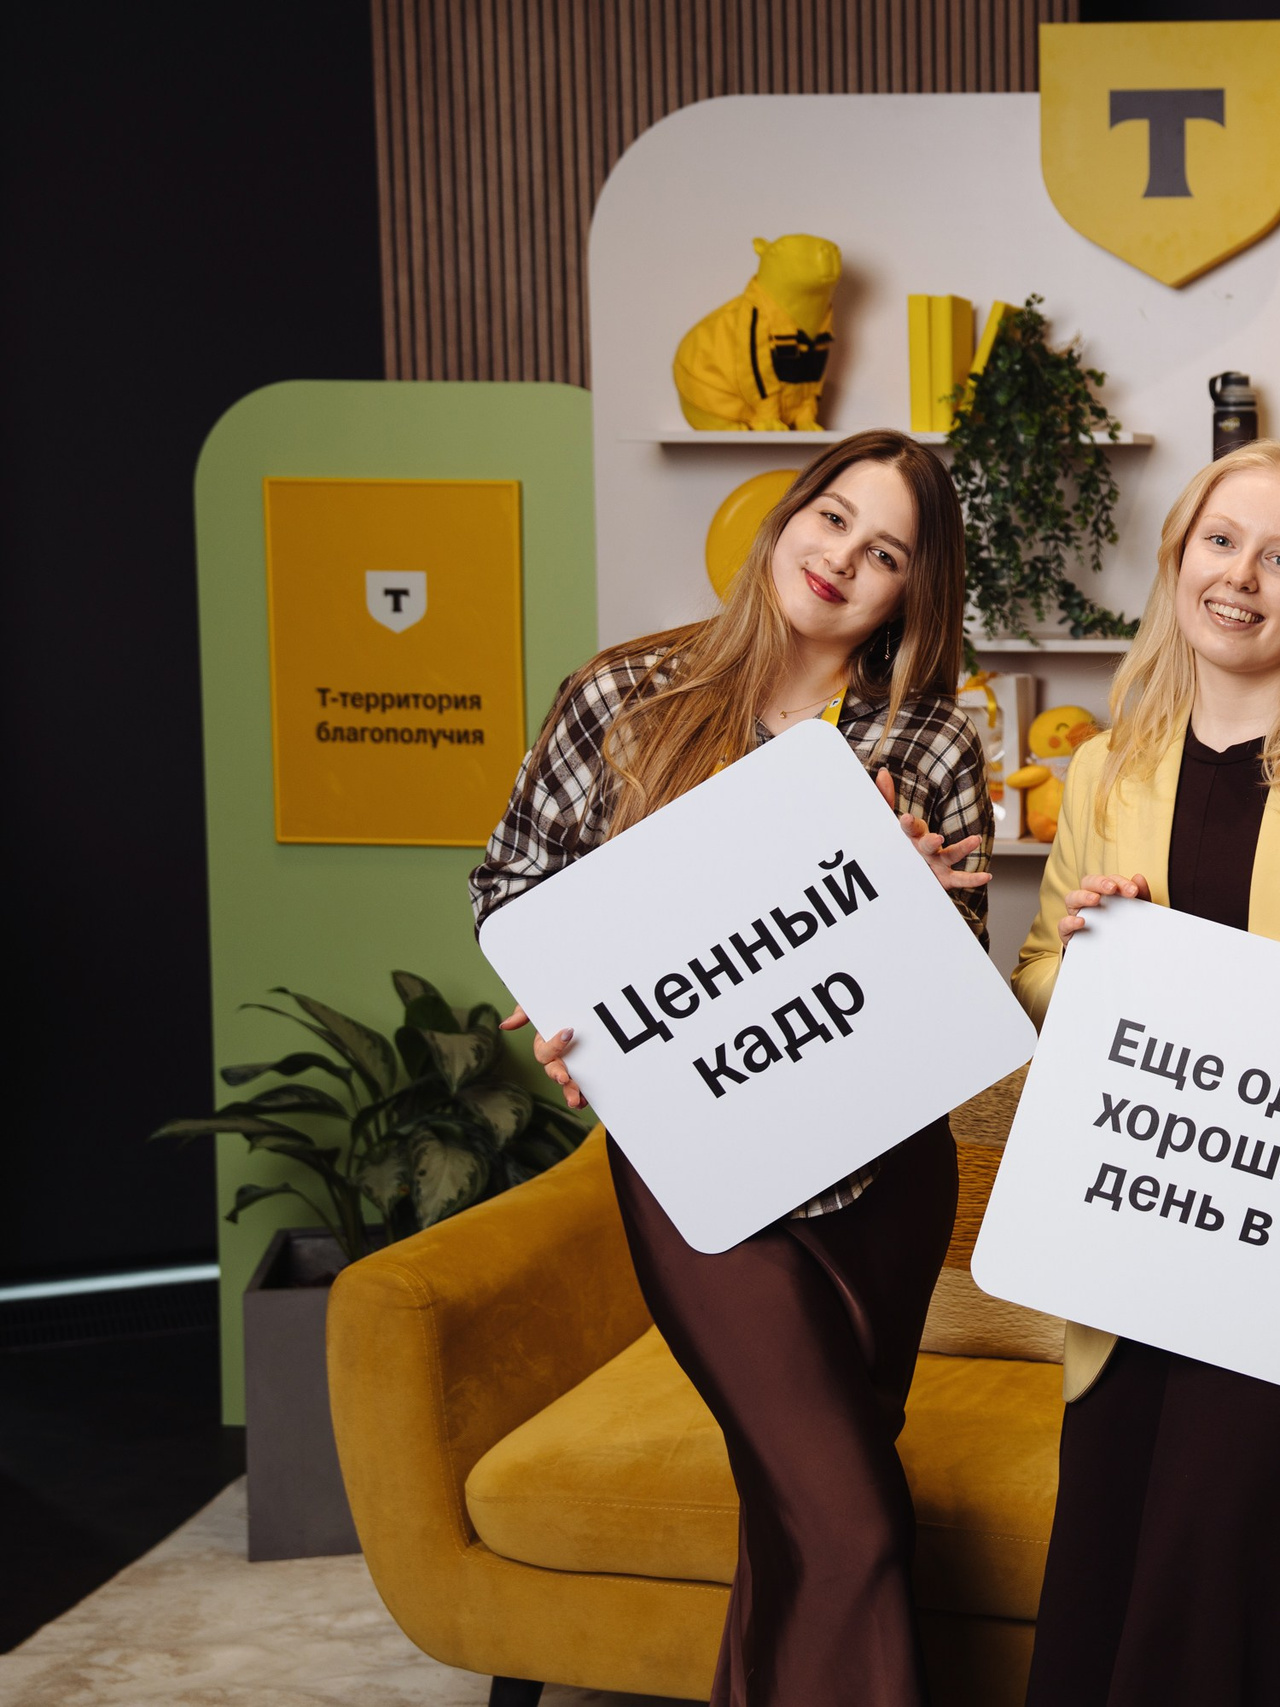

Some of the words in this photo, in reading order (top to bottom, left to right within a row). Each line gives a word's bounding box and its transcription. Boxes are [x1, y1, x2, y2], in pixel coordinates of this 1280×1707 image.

[1108, 87, 1226, 199] Т
[382, 587, 410, 614] Т
[315, 687, 482, 715] Т-территория
[315, 721, 485, 749] благополучия
[593, 849, 879, 1055] Ценный
[692, 971, 865, 1099] кадр
[1108, 1018, 1225, 1092] Еще
[1083, 1162, 1225, 1232] день
[1238, 1207, 1273, 1247] в
